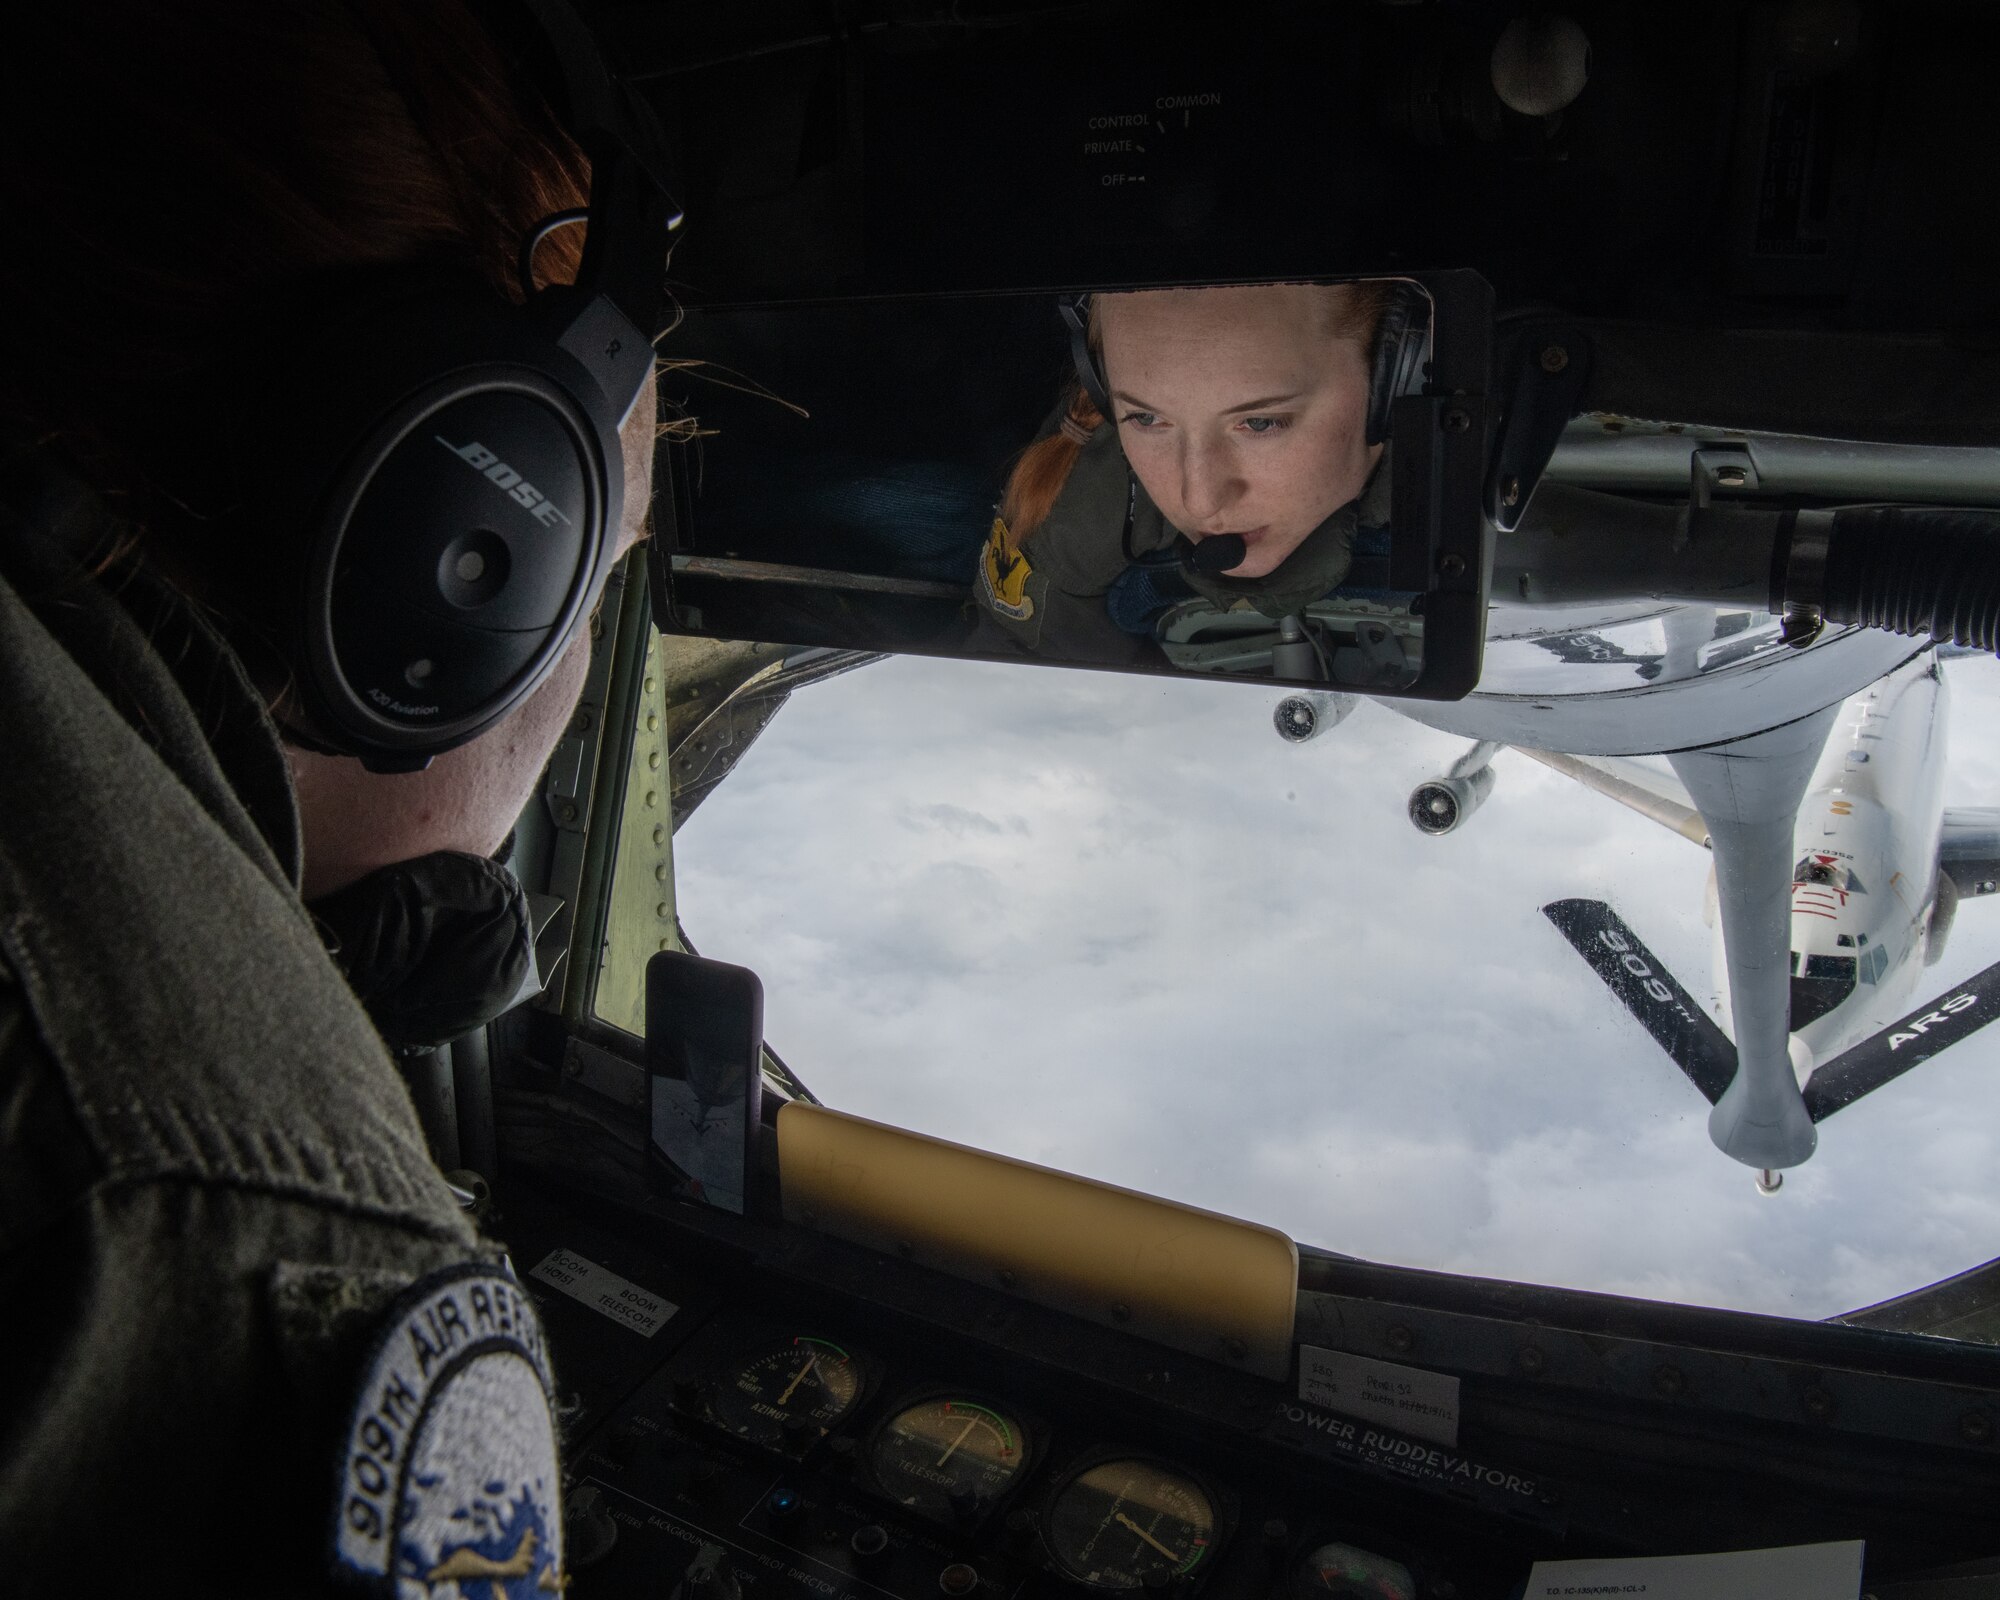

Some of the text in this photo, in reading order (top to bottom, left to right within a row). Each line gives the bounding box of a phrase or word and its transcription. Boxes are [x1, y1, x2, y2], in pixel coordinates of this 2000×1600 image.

[1155, 92, 1221, 110] COMMON
[1088, 114, 1149, 130] CONTROL
[1084, 140, 1133, 155] PRIVATE
[1102, 174, 1126, 187] OFF
[604, 337, 623, 360] R
[434, 434, 572, 530] BOSE
[367, 686, 440, 717] A20 Aviation
[1887, 991, 1979, 1052] ARS
[620, 1288, 658, 1313] BOOM
[598, 1294, 657, 1329] TELESCOPE
[736, 1379, 764, 1395] RIGHT
[347, 1371, 418, 1540] 909TH
[406, 1294, 469, 1378] AIR
[810, 1408, 833, 1422] LEFT
[1273, 1402, 1538, 1497] POWER RUDDEVATORS
[1335, 1439, 1354, 1452] SEE
[982, 1471, 1001, 1483] OUT
[757, 1553, 785, 1572] PILOT
[786, 1566, 837, 1598] DIRECTOR
[1102, 1566, 1137, 1586] DOWN
